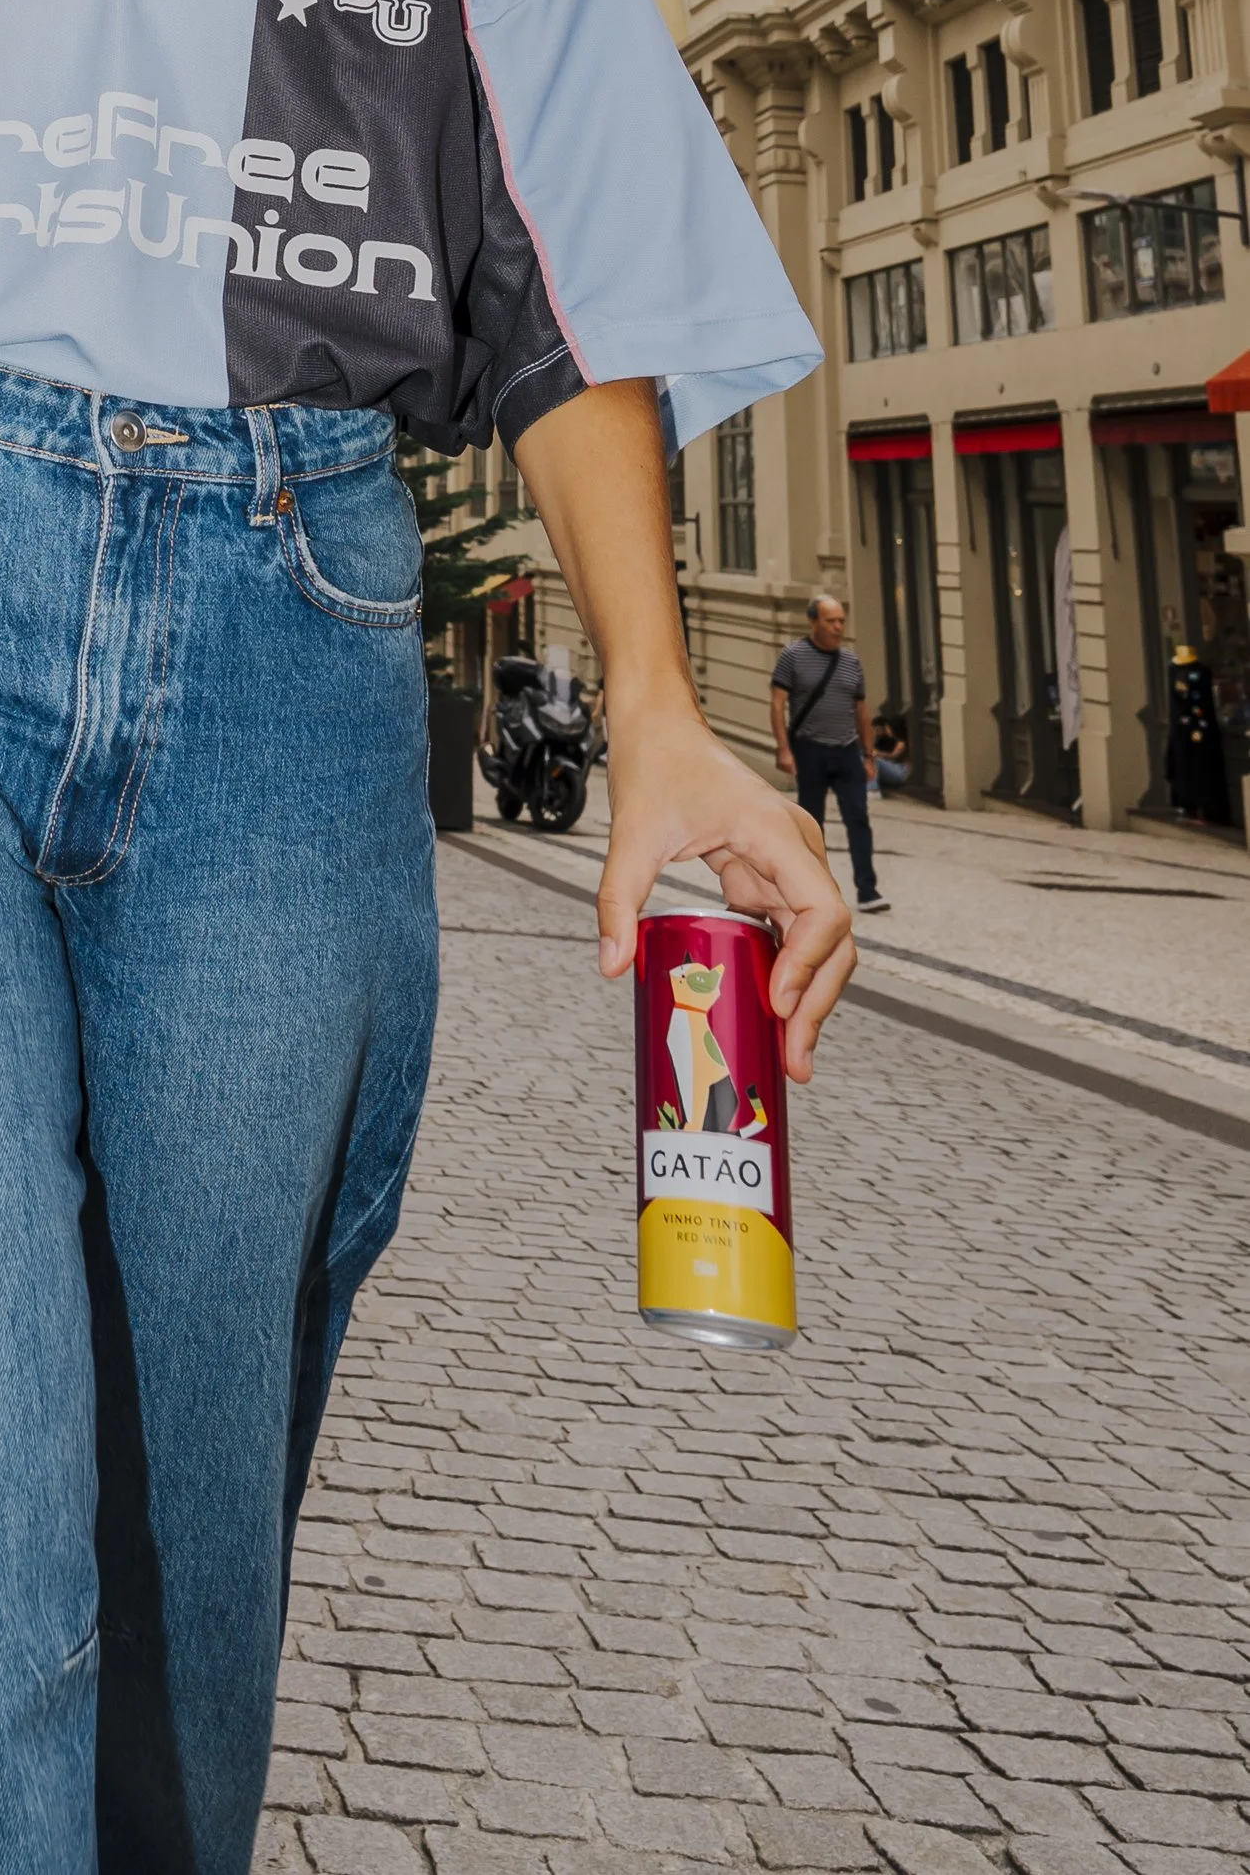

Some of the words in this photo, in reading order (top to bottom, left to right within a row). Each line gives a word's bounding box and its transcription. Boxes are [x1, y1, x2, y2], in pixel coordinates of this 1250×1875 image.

[650, 1149, 762, 1188] GATÃO
[663, 1212, 703, 1226] VINHO
[710, 1218, 749, 1233] TINTO
[677, 1231, 699, 1243] RED
[703, 1234, 733, 1247] WINE
